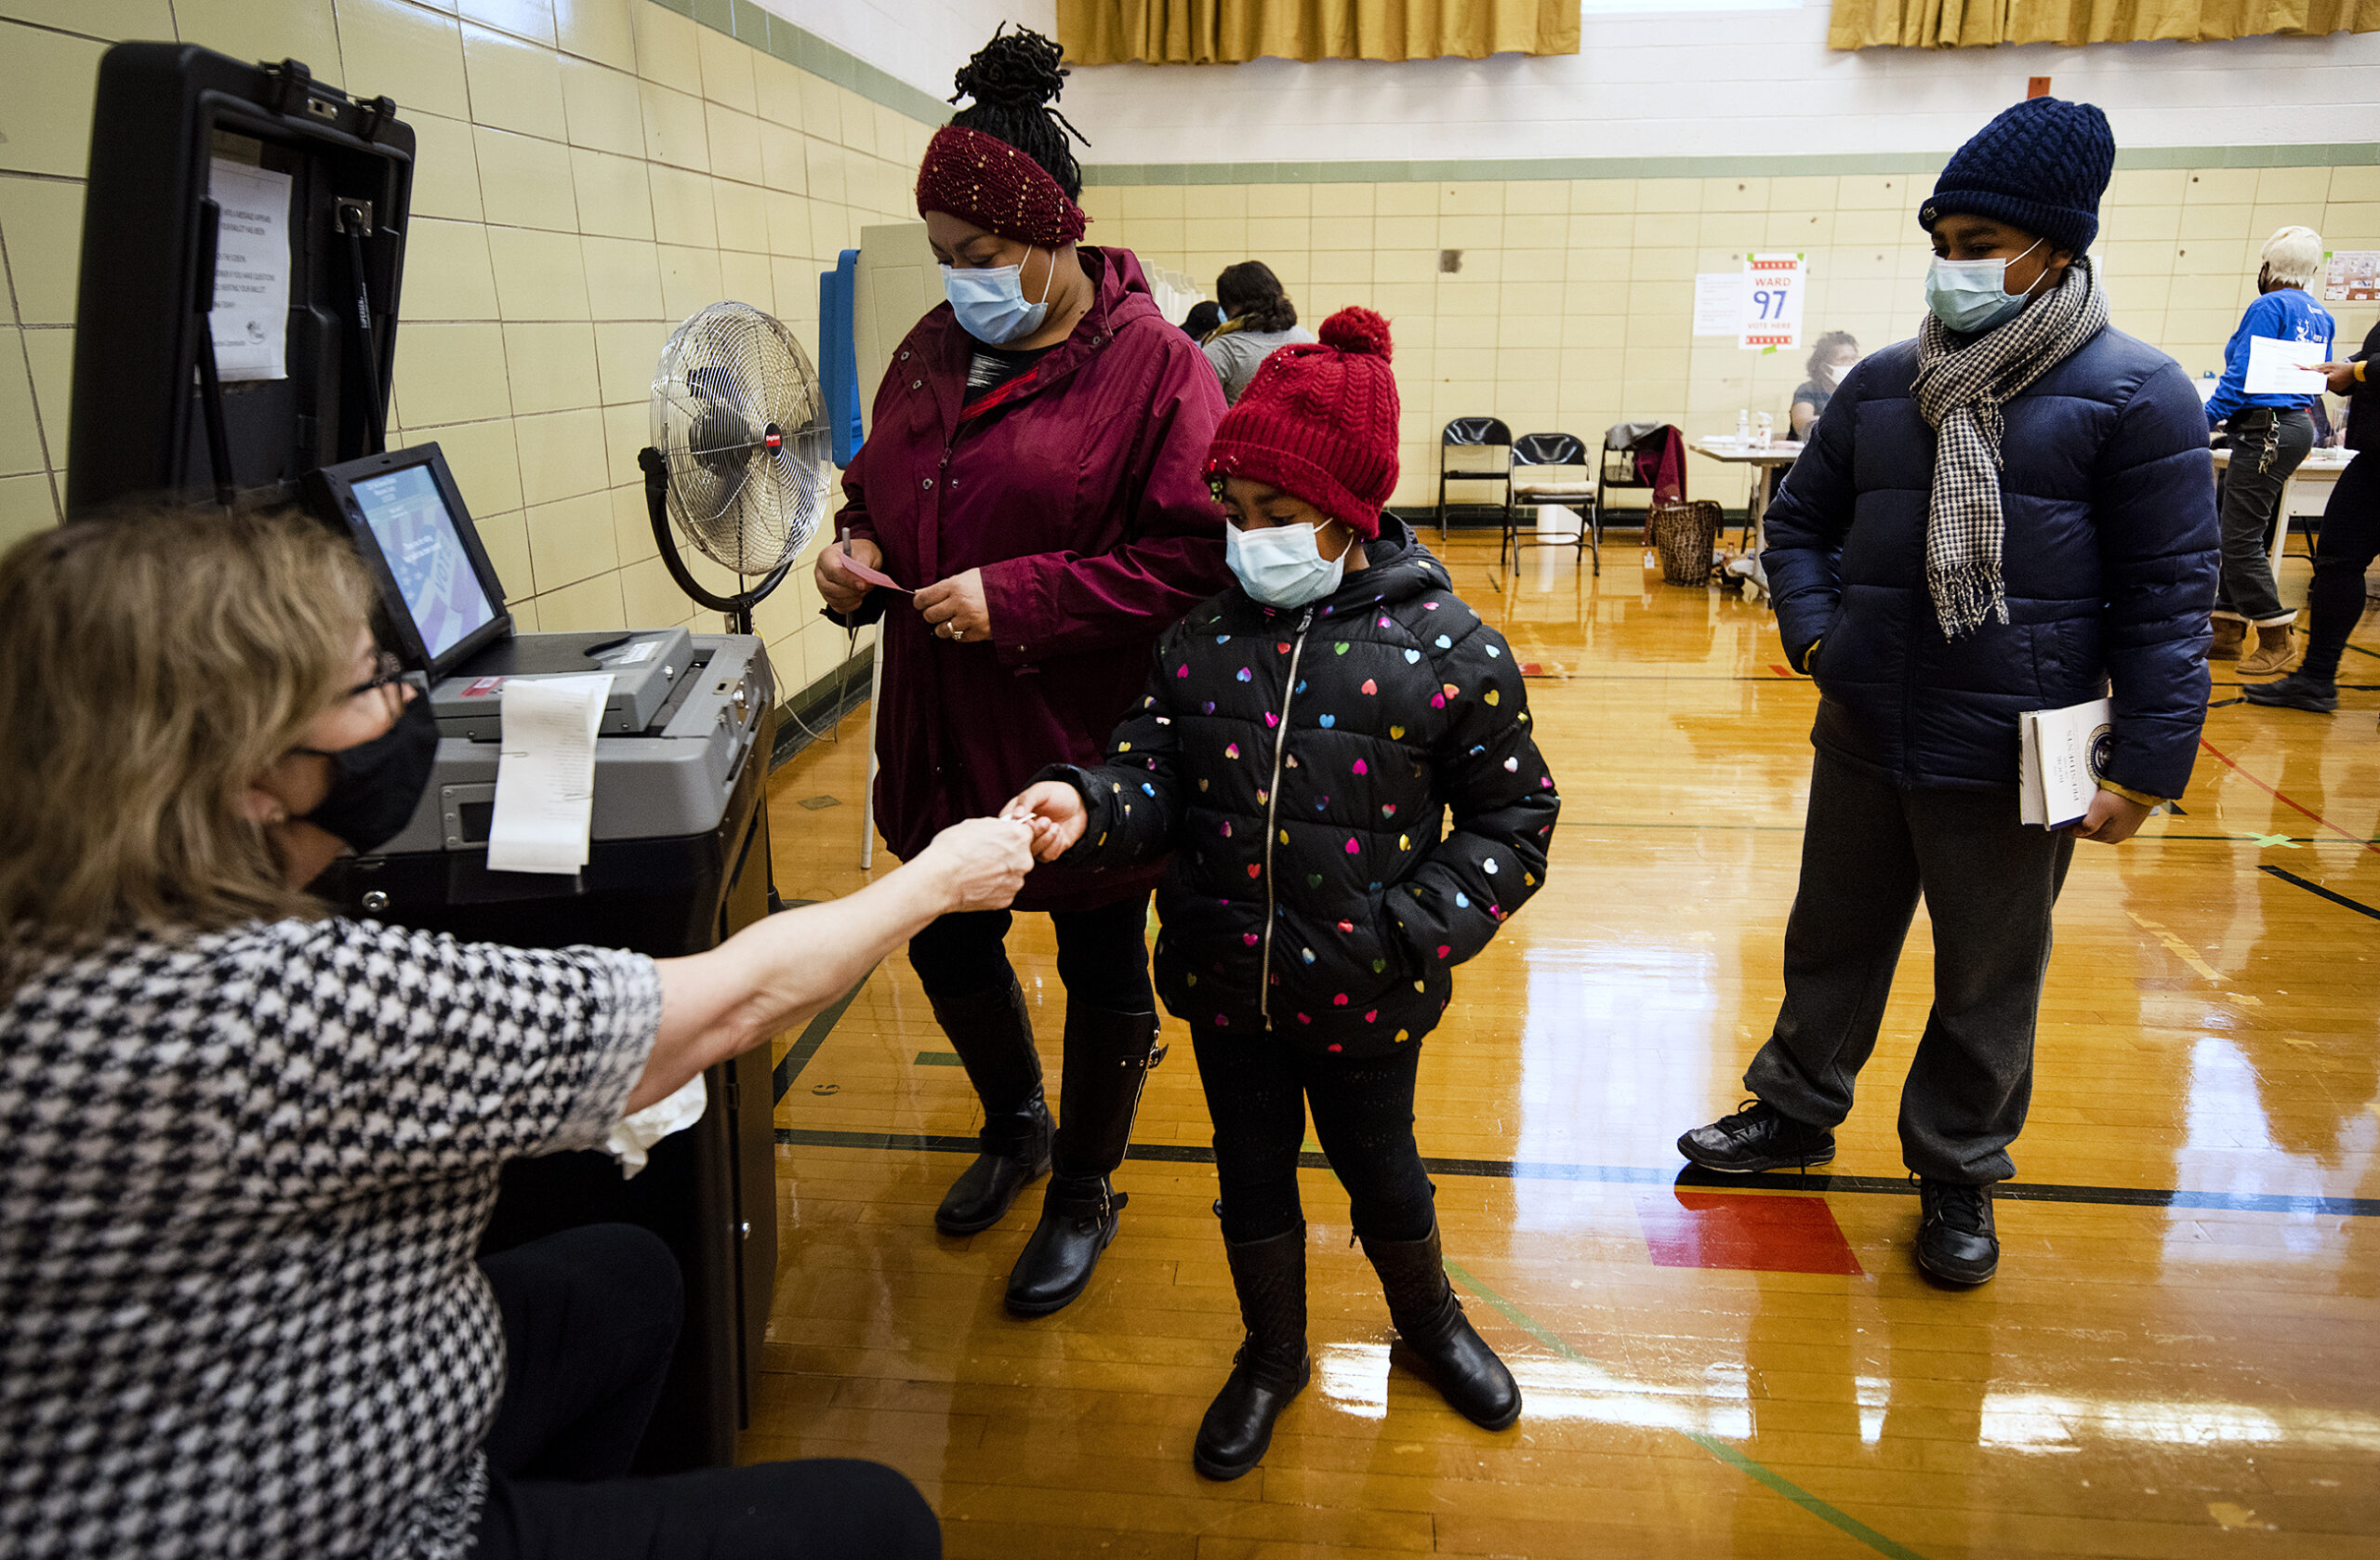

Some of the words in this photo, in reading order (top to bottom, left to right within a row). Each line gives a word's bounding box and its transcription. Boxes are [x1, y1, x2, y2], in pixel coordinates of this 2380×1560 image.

[1755, 277, 1792, 286] WARD
[1753, 291, 1787, 320] 97
[2067, 729, 2080, 801] PRESIDENTS
